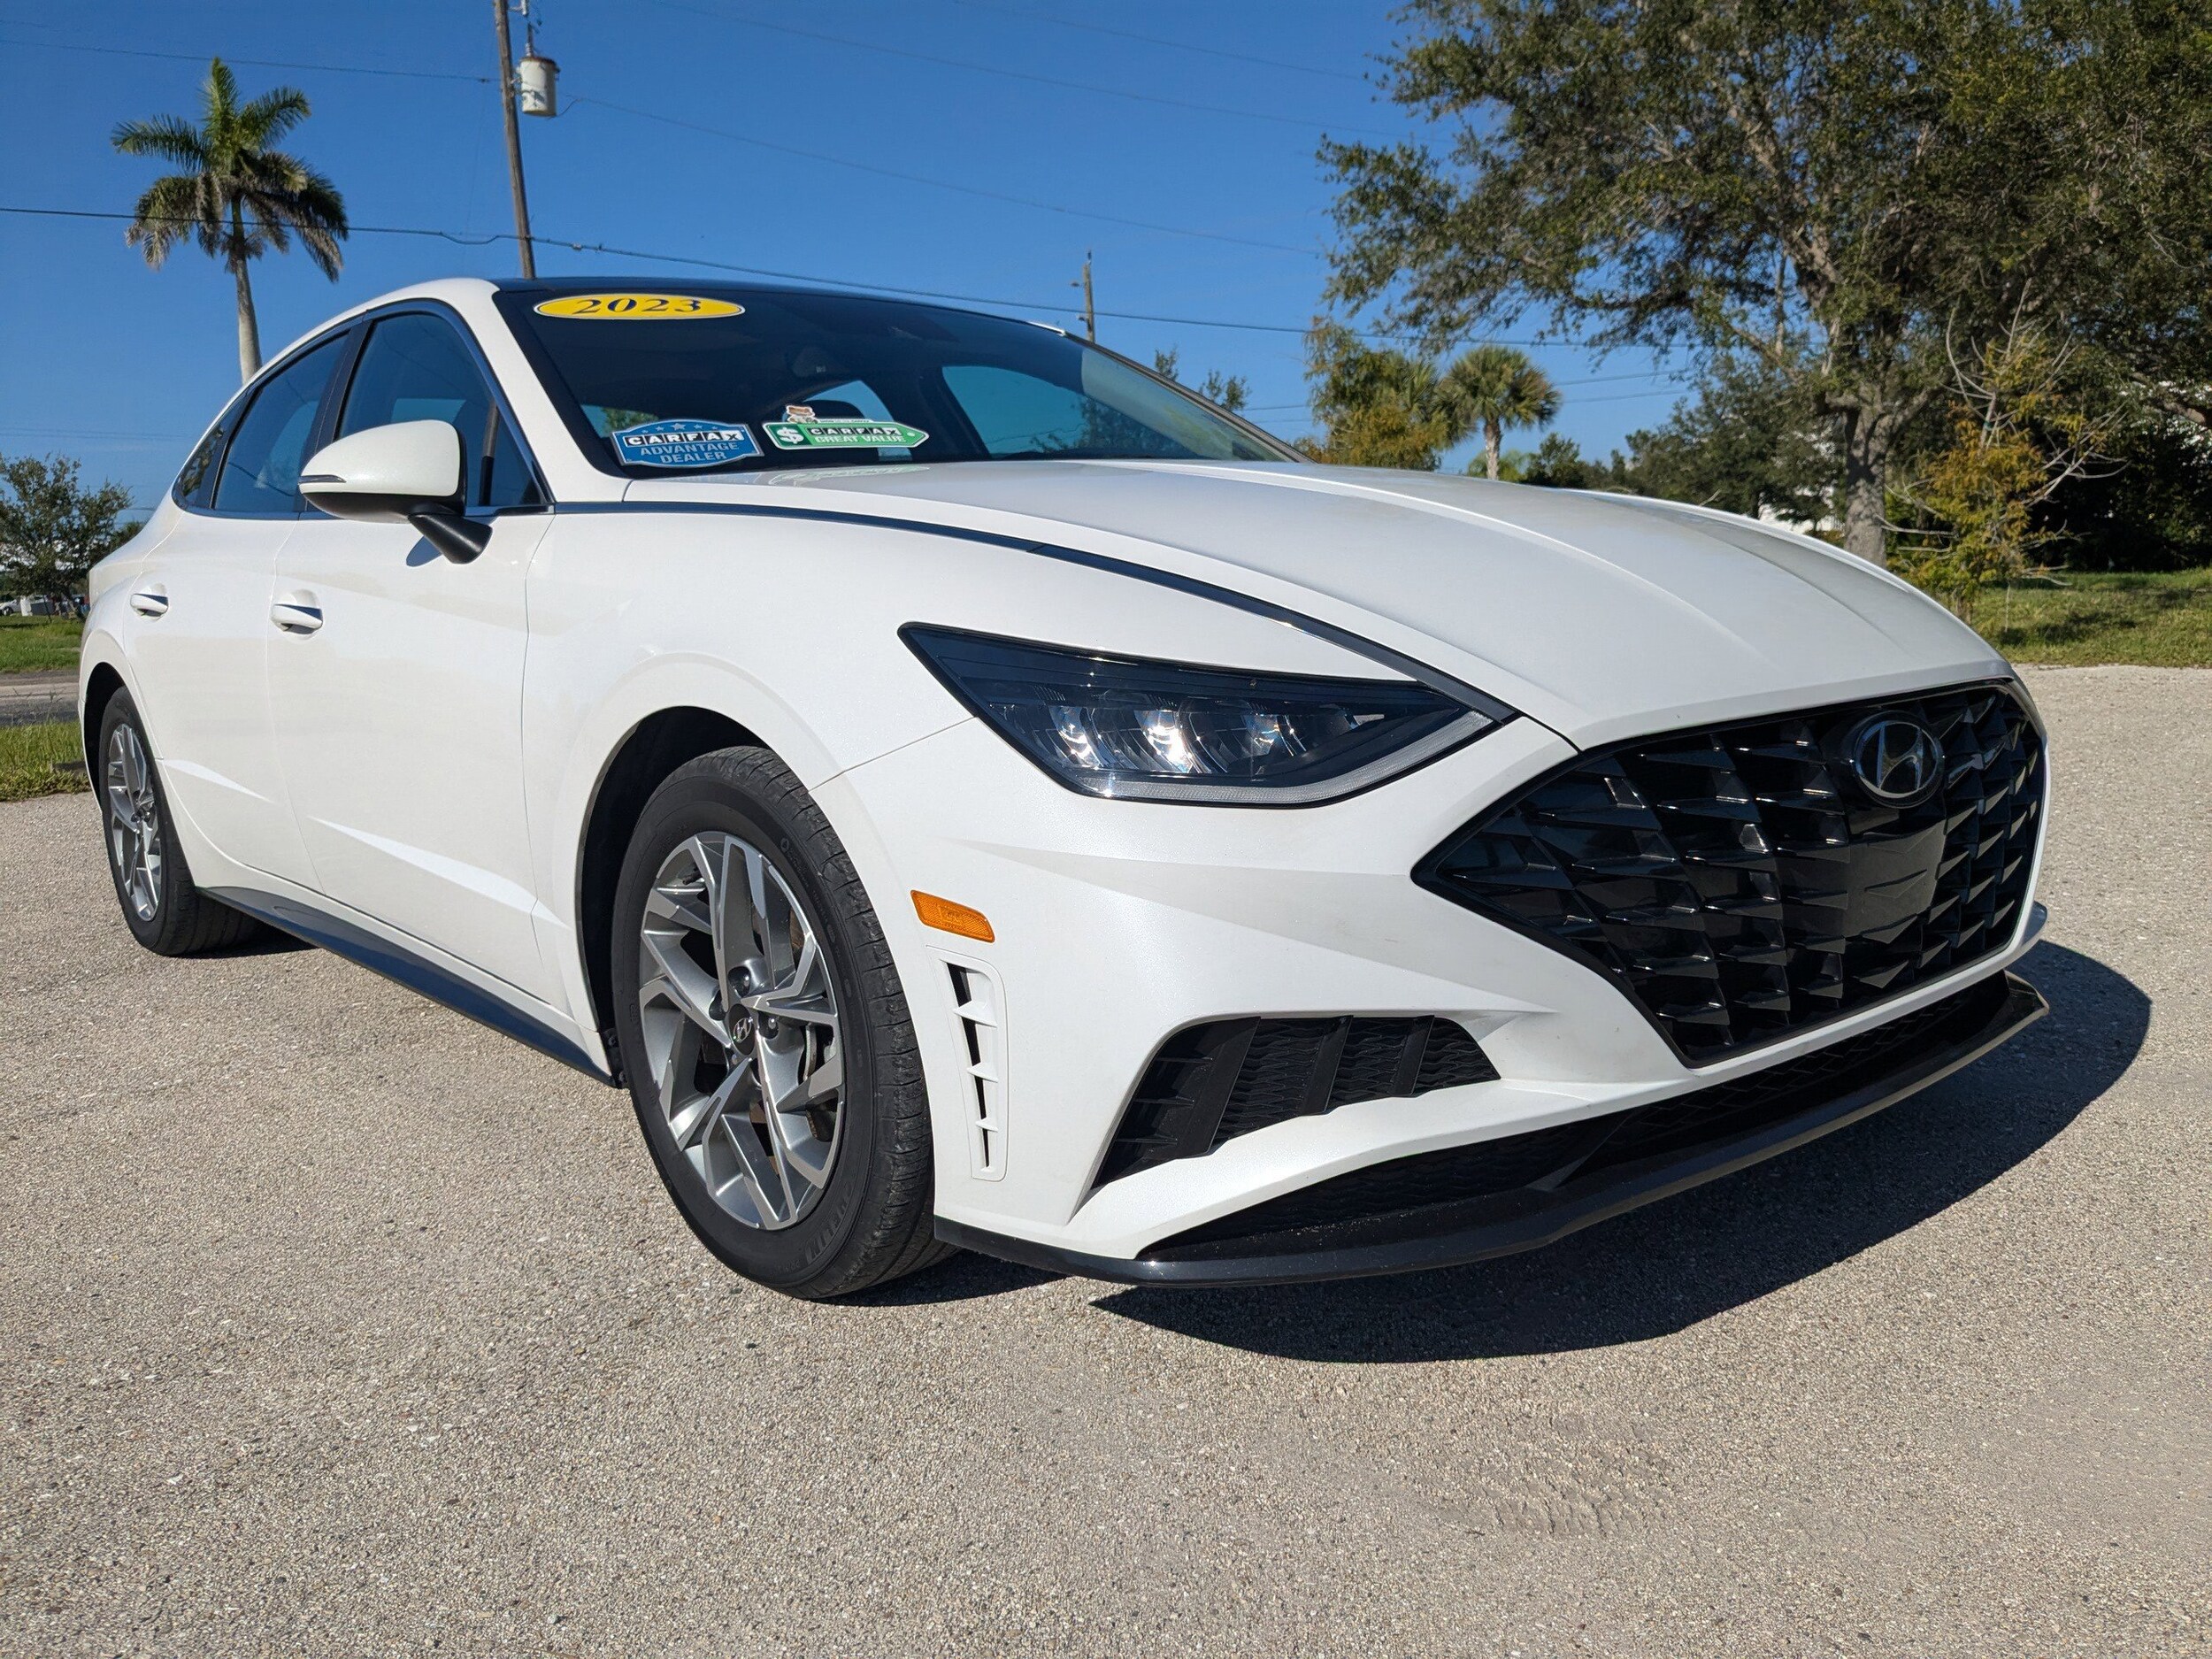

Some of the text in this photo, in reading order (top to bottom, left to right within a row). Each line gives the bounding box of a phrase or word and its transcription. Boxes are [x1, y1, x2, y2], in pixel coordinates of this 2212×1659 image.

[572, 299, 702, 314] 2023
[626, 430, 743, 447] CARFAX
[809, 427, 902, 437] CARFAX
[641, 442, 739, 456] ADVANTAGE
[662, 452, 726, 464] DEALER
